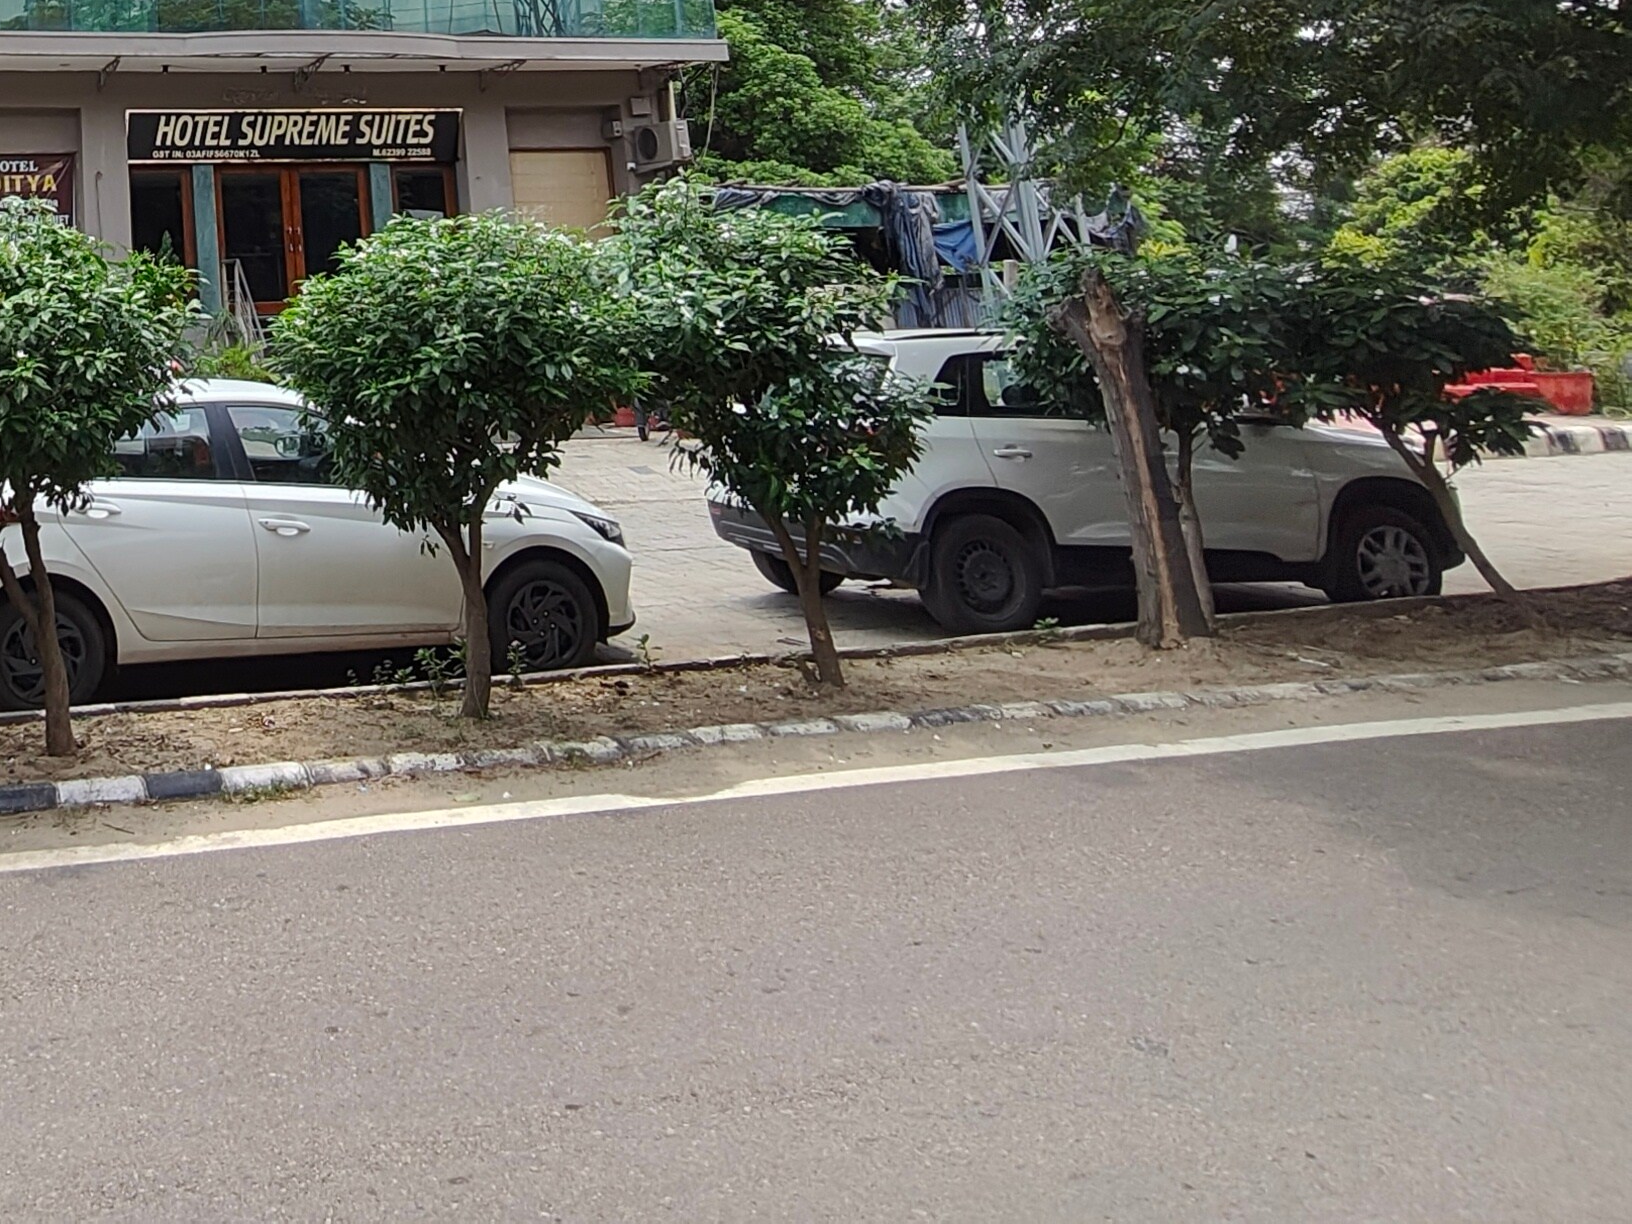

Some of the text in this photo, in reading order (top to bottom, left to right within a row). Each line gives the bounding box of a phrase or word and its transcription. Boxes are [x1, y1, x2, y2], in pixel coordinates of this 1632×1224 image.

[155, 113, 436, 147] HOTEL SUPREME SUITES
[152, 149, 171, 159] GST
